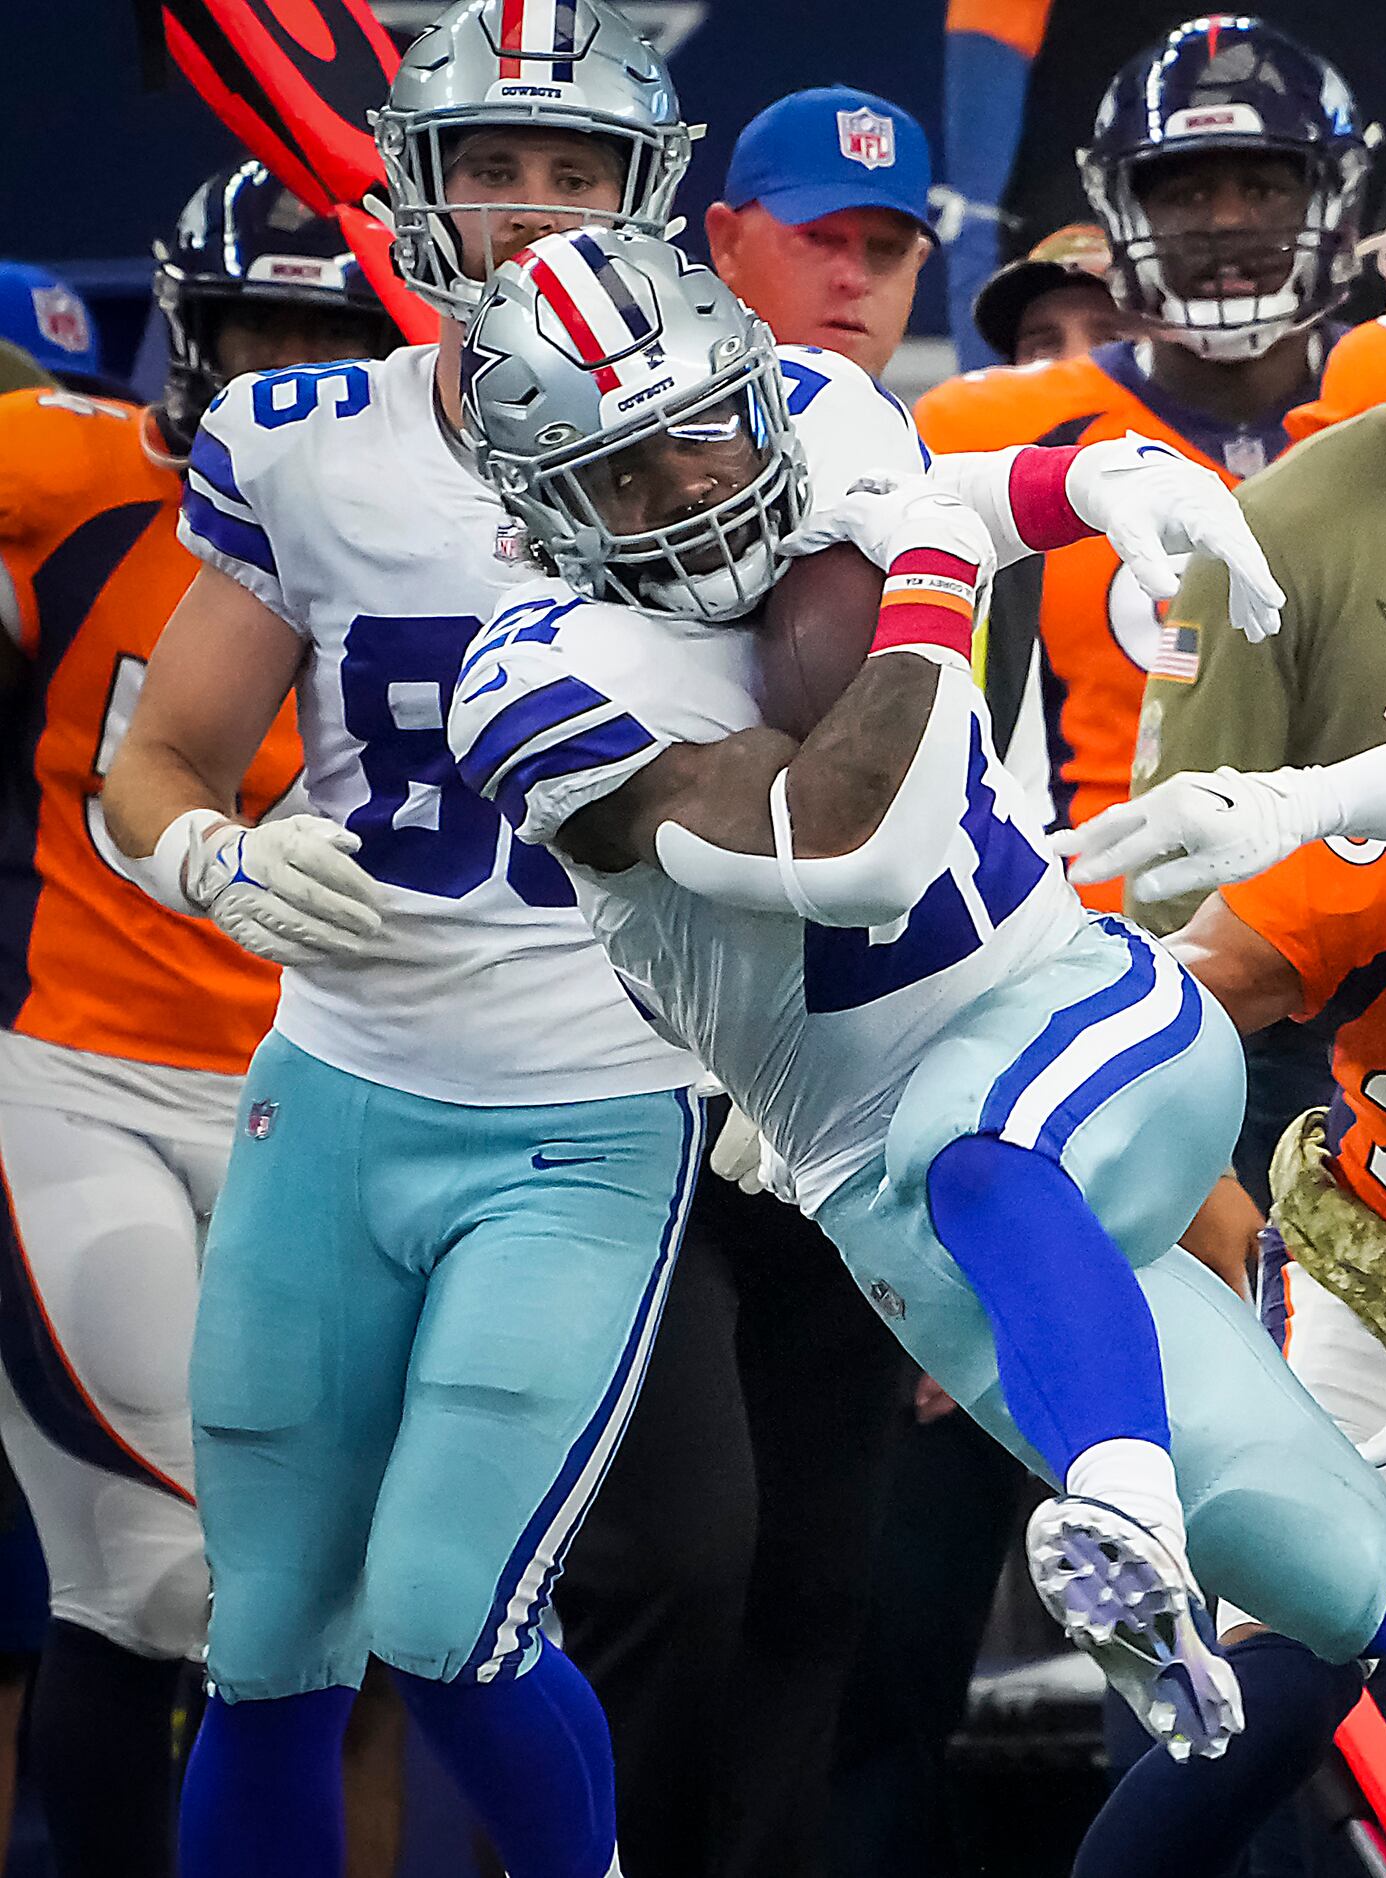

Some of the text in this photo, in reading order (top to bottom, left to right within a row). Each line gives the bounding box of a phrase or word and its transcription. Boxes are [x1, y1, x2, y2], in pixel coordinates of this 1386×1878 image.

[502, 86, 561, 98] COWBOYS
[848, 131, 888, 159] NFL
[617, 376, 675, 412] COWBOYS
